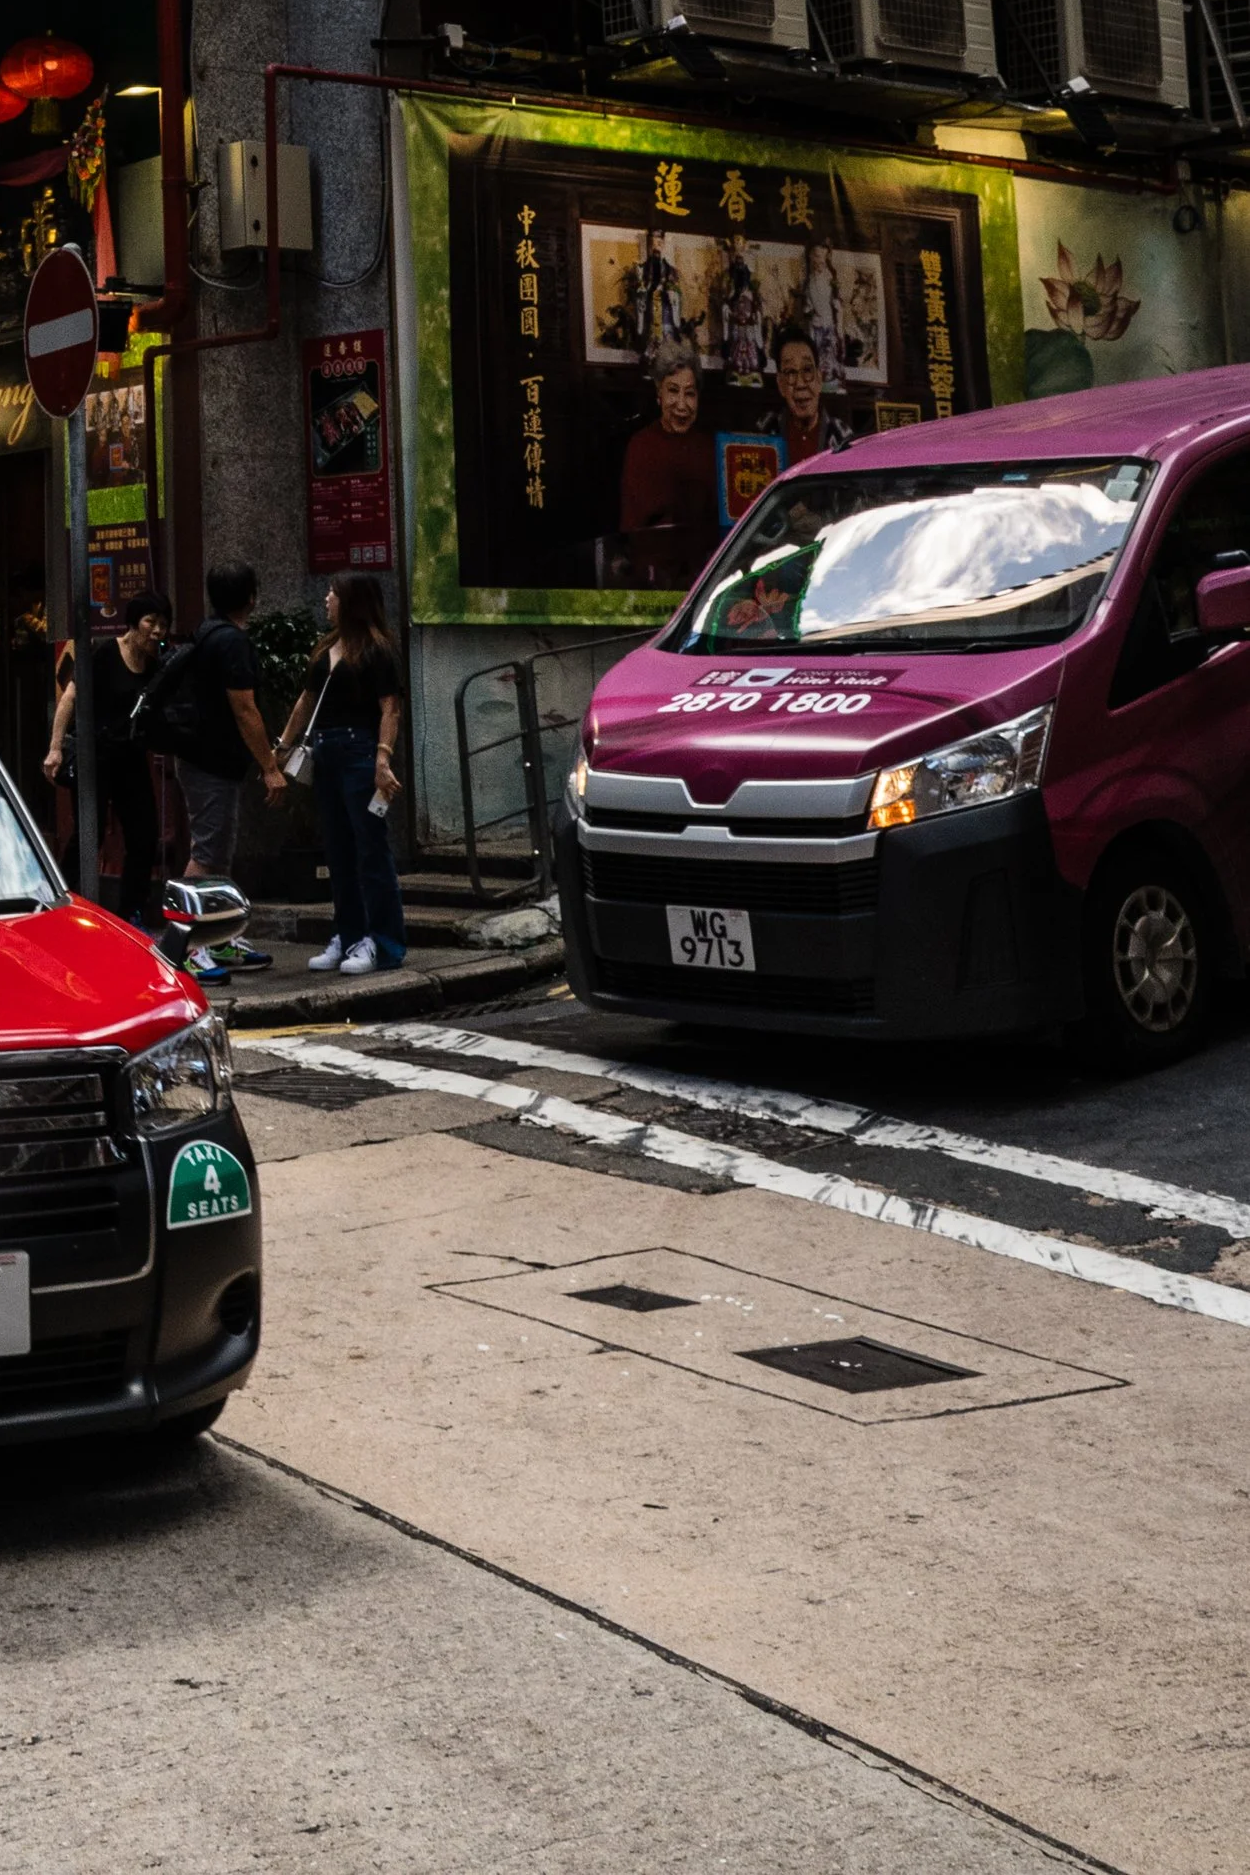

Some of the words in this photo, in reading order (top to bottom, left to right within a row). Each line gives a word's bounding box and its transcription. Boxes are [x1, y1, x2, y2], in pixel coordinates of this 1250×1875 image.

[654, 161, 815, 230] 蓮香樓
[656, 692, 762, 713] 2870
[767, 692, 872, 714] 1800
[689, 909, 727, 939] WG
[680, 936, 745, 967] 9713
[183, 1144, 223, 1167] TAXI
[204, 1164, 222, 1196] 4
[187, 1195, 240, 1219] SEATS
